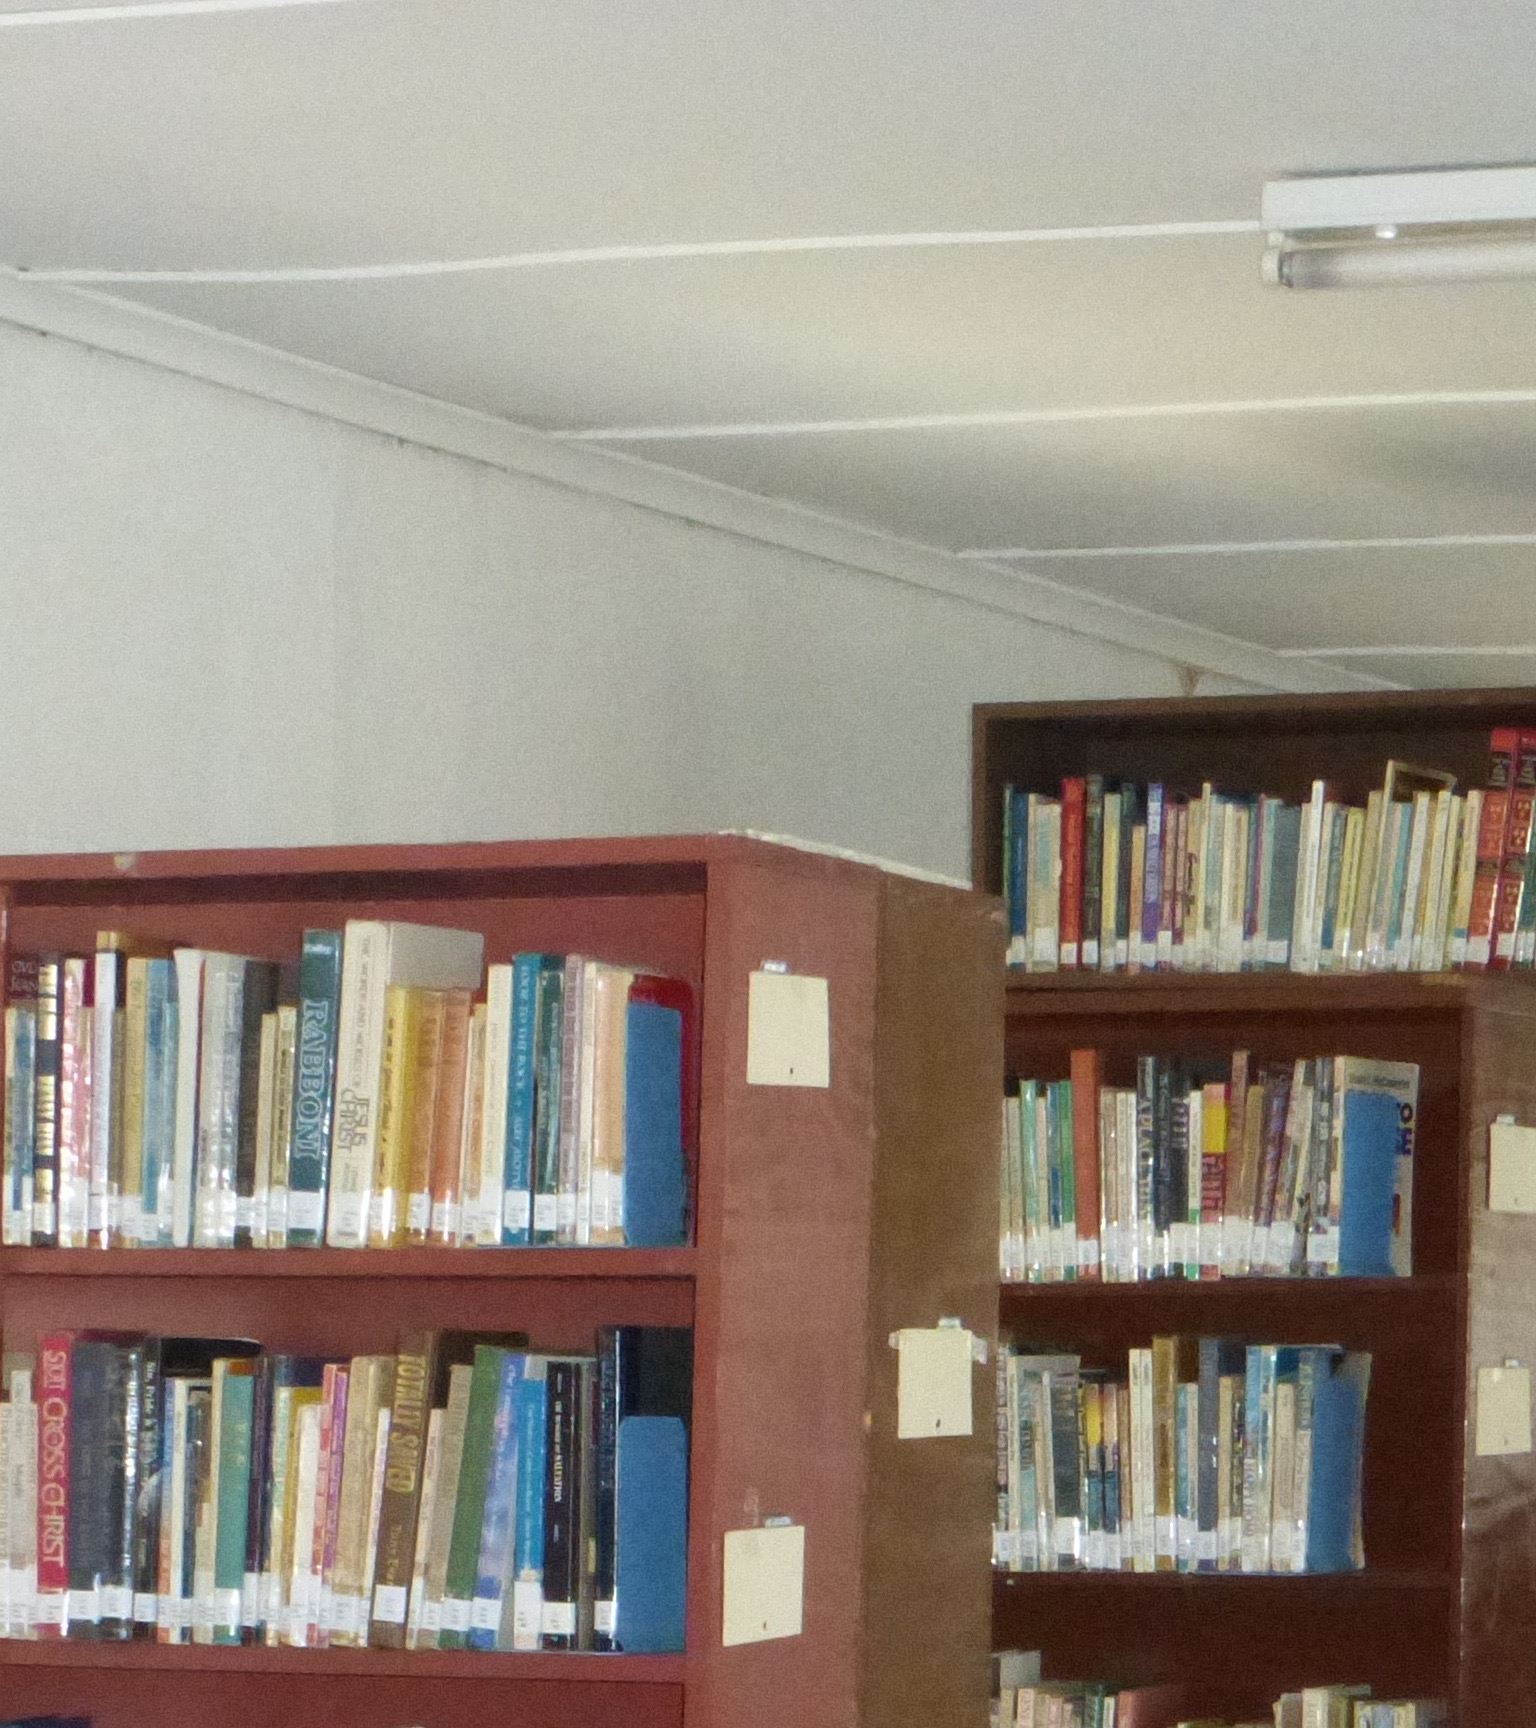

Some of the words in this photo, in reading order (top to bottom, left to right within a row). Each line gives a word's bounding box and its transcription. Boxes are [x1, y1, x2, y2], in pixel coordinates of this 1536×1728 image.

[294, 1000, 329, 1160] RABBONI
[42, 1396, 66, 1478] CROSS
[41, 1483, 66, 1568] CHRIST
